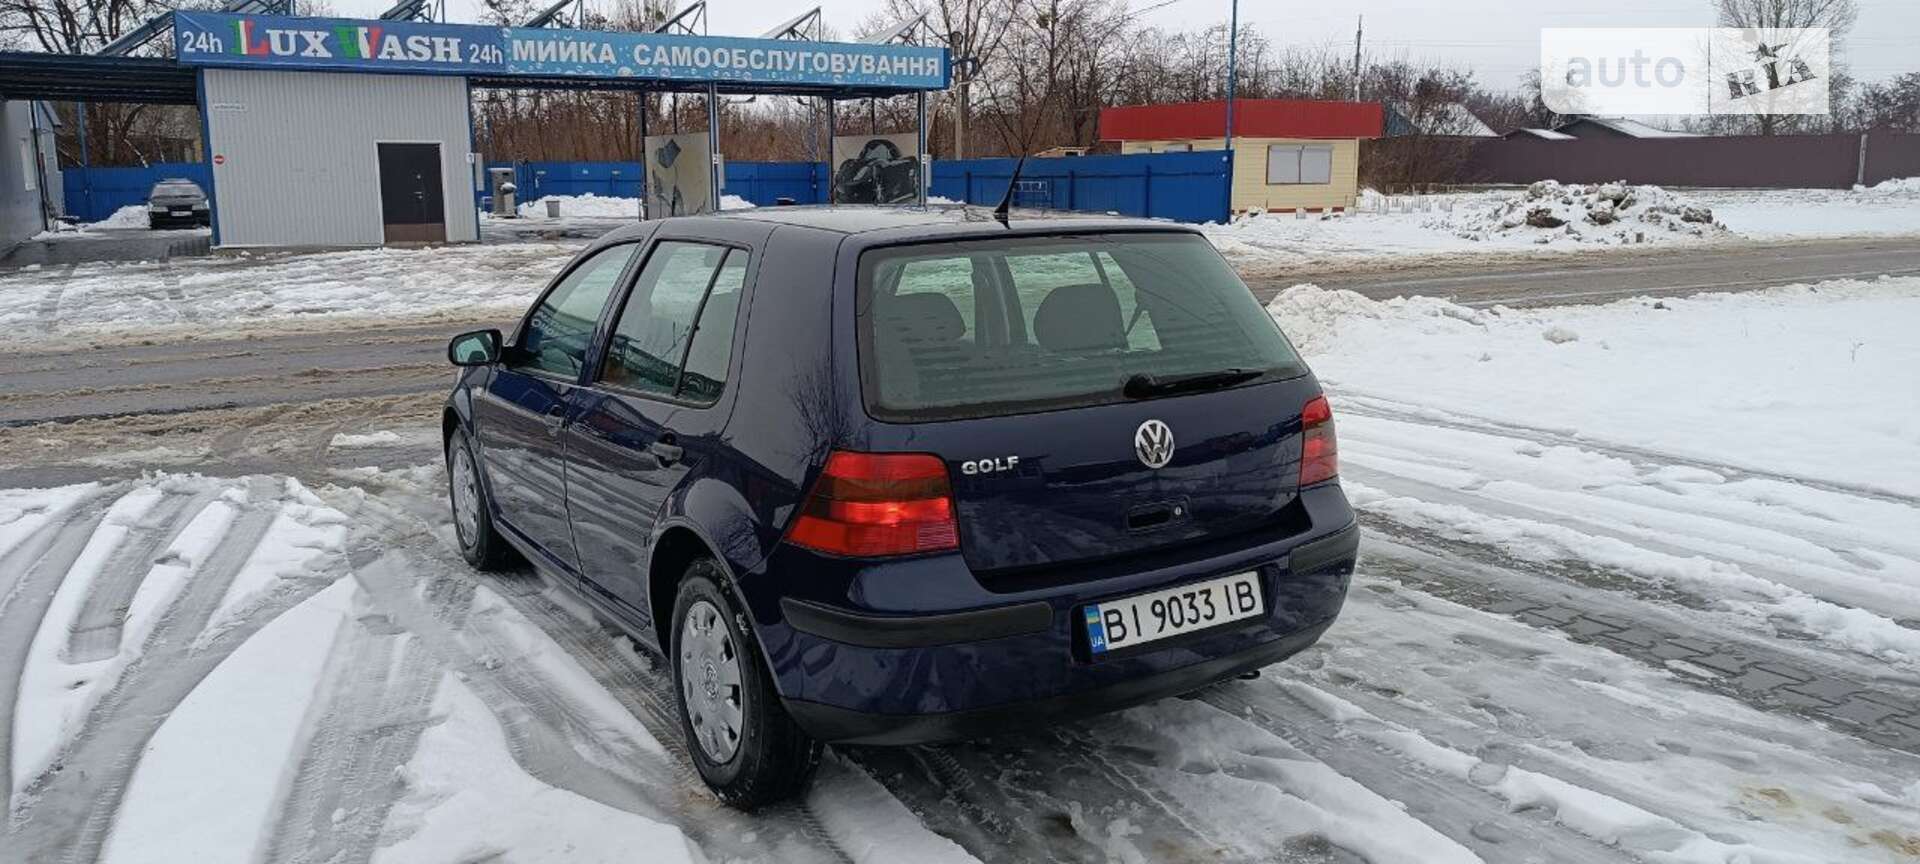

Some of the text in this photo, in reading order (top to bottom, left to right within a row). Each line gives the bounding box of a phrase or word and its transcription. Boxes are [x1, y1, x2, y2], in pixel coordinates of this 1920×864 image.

[182, 31, 223, 53] 24h
[469, 43, 503, 65] 24h
[512, 36, 940, 77] МИЙКА САМООБСЛУГОВУВАННЯ
[961, 456, 1019, 475] GOLF
[1104, 581, 1257, 643] BI 9033 IB
[1091, 636, 1104, 647] UA
